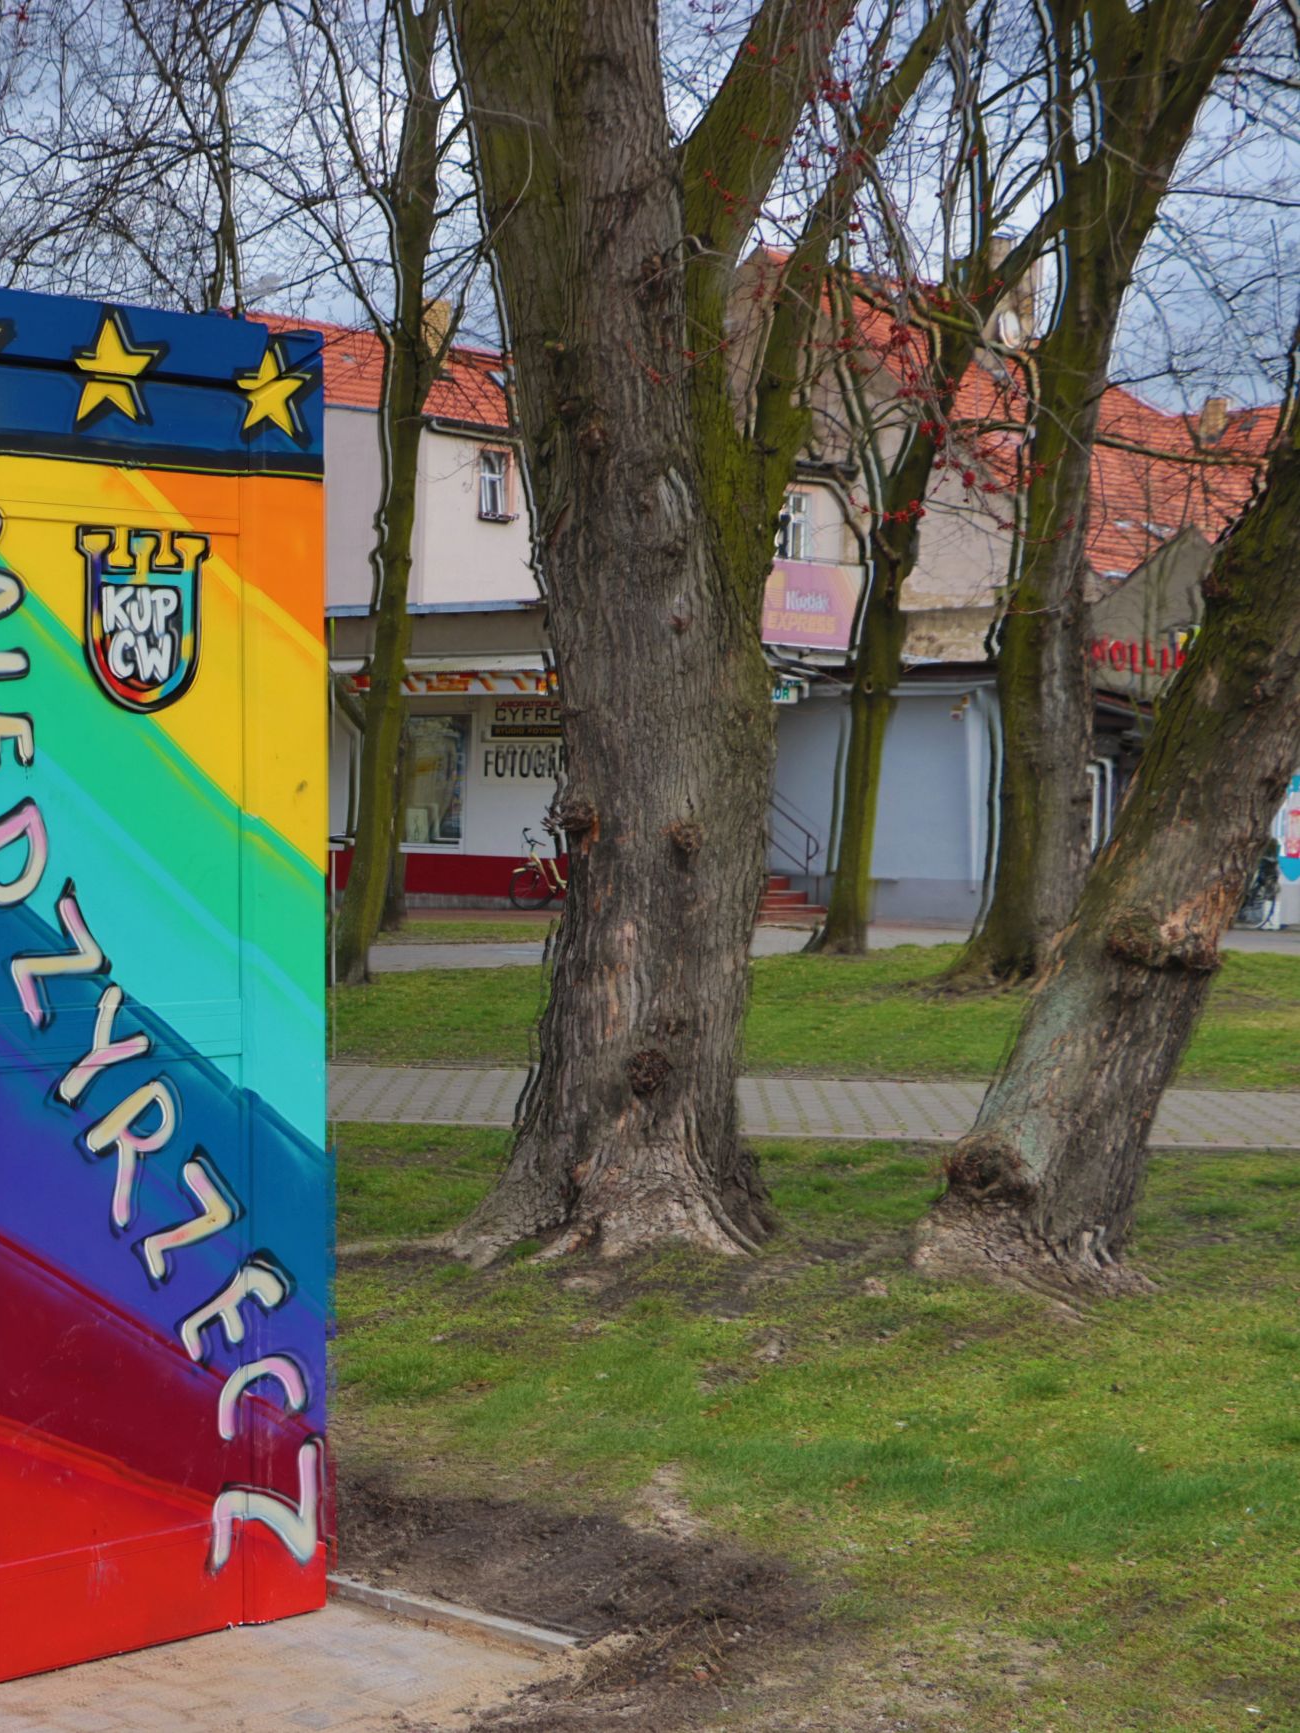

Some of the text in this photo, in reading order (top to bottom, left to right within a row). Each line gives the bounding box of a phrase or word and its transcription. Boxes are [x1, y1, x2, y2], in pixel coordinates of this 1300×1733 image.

[102, 584, 178, 639] KUP
[766, 610, 837, 635] EXPRESS
[108, 629, 173, 683] CW
